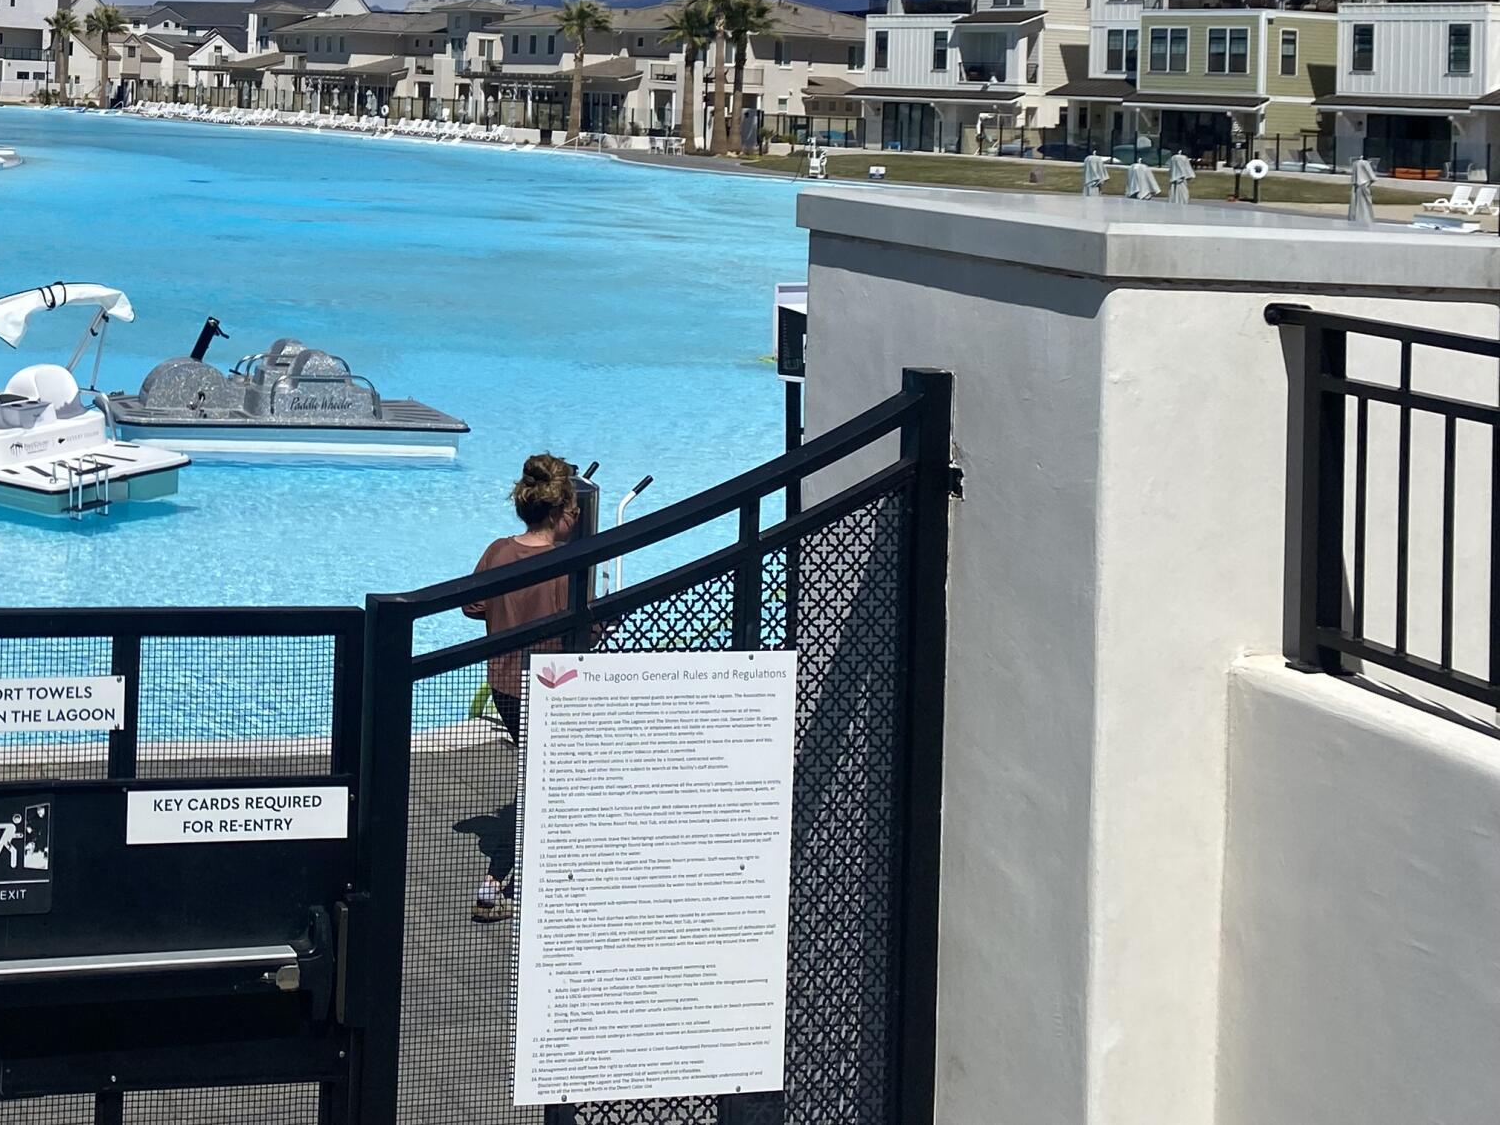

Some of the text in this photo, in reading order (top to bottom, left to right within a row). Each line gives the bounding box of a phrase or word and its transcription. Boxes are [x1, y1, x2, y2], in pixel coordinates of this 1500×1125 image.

[289, 396, 353, 411] Paddle Wheeler
[583, 669, 786, 683] The Lagoon General Rules and Regulations
[27, 686, 92, 700] TOWELS
[11, 710, 41, 723] THE
[47, 708, 116, 722] LAGOON
[154, 795, 322, 811] KEY CARDS REQUIRED
[183, 818, 292, 833] FOR RE-ENTRY
[0, 889, 26, 900] EXIT
